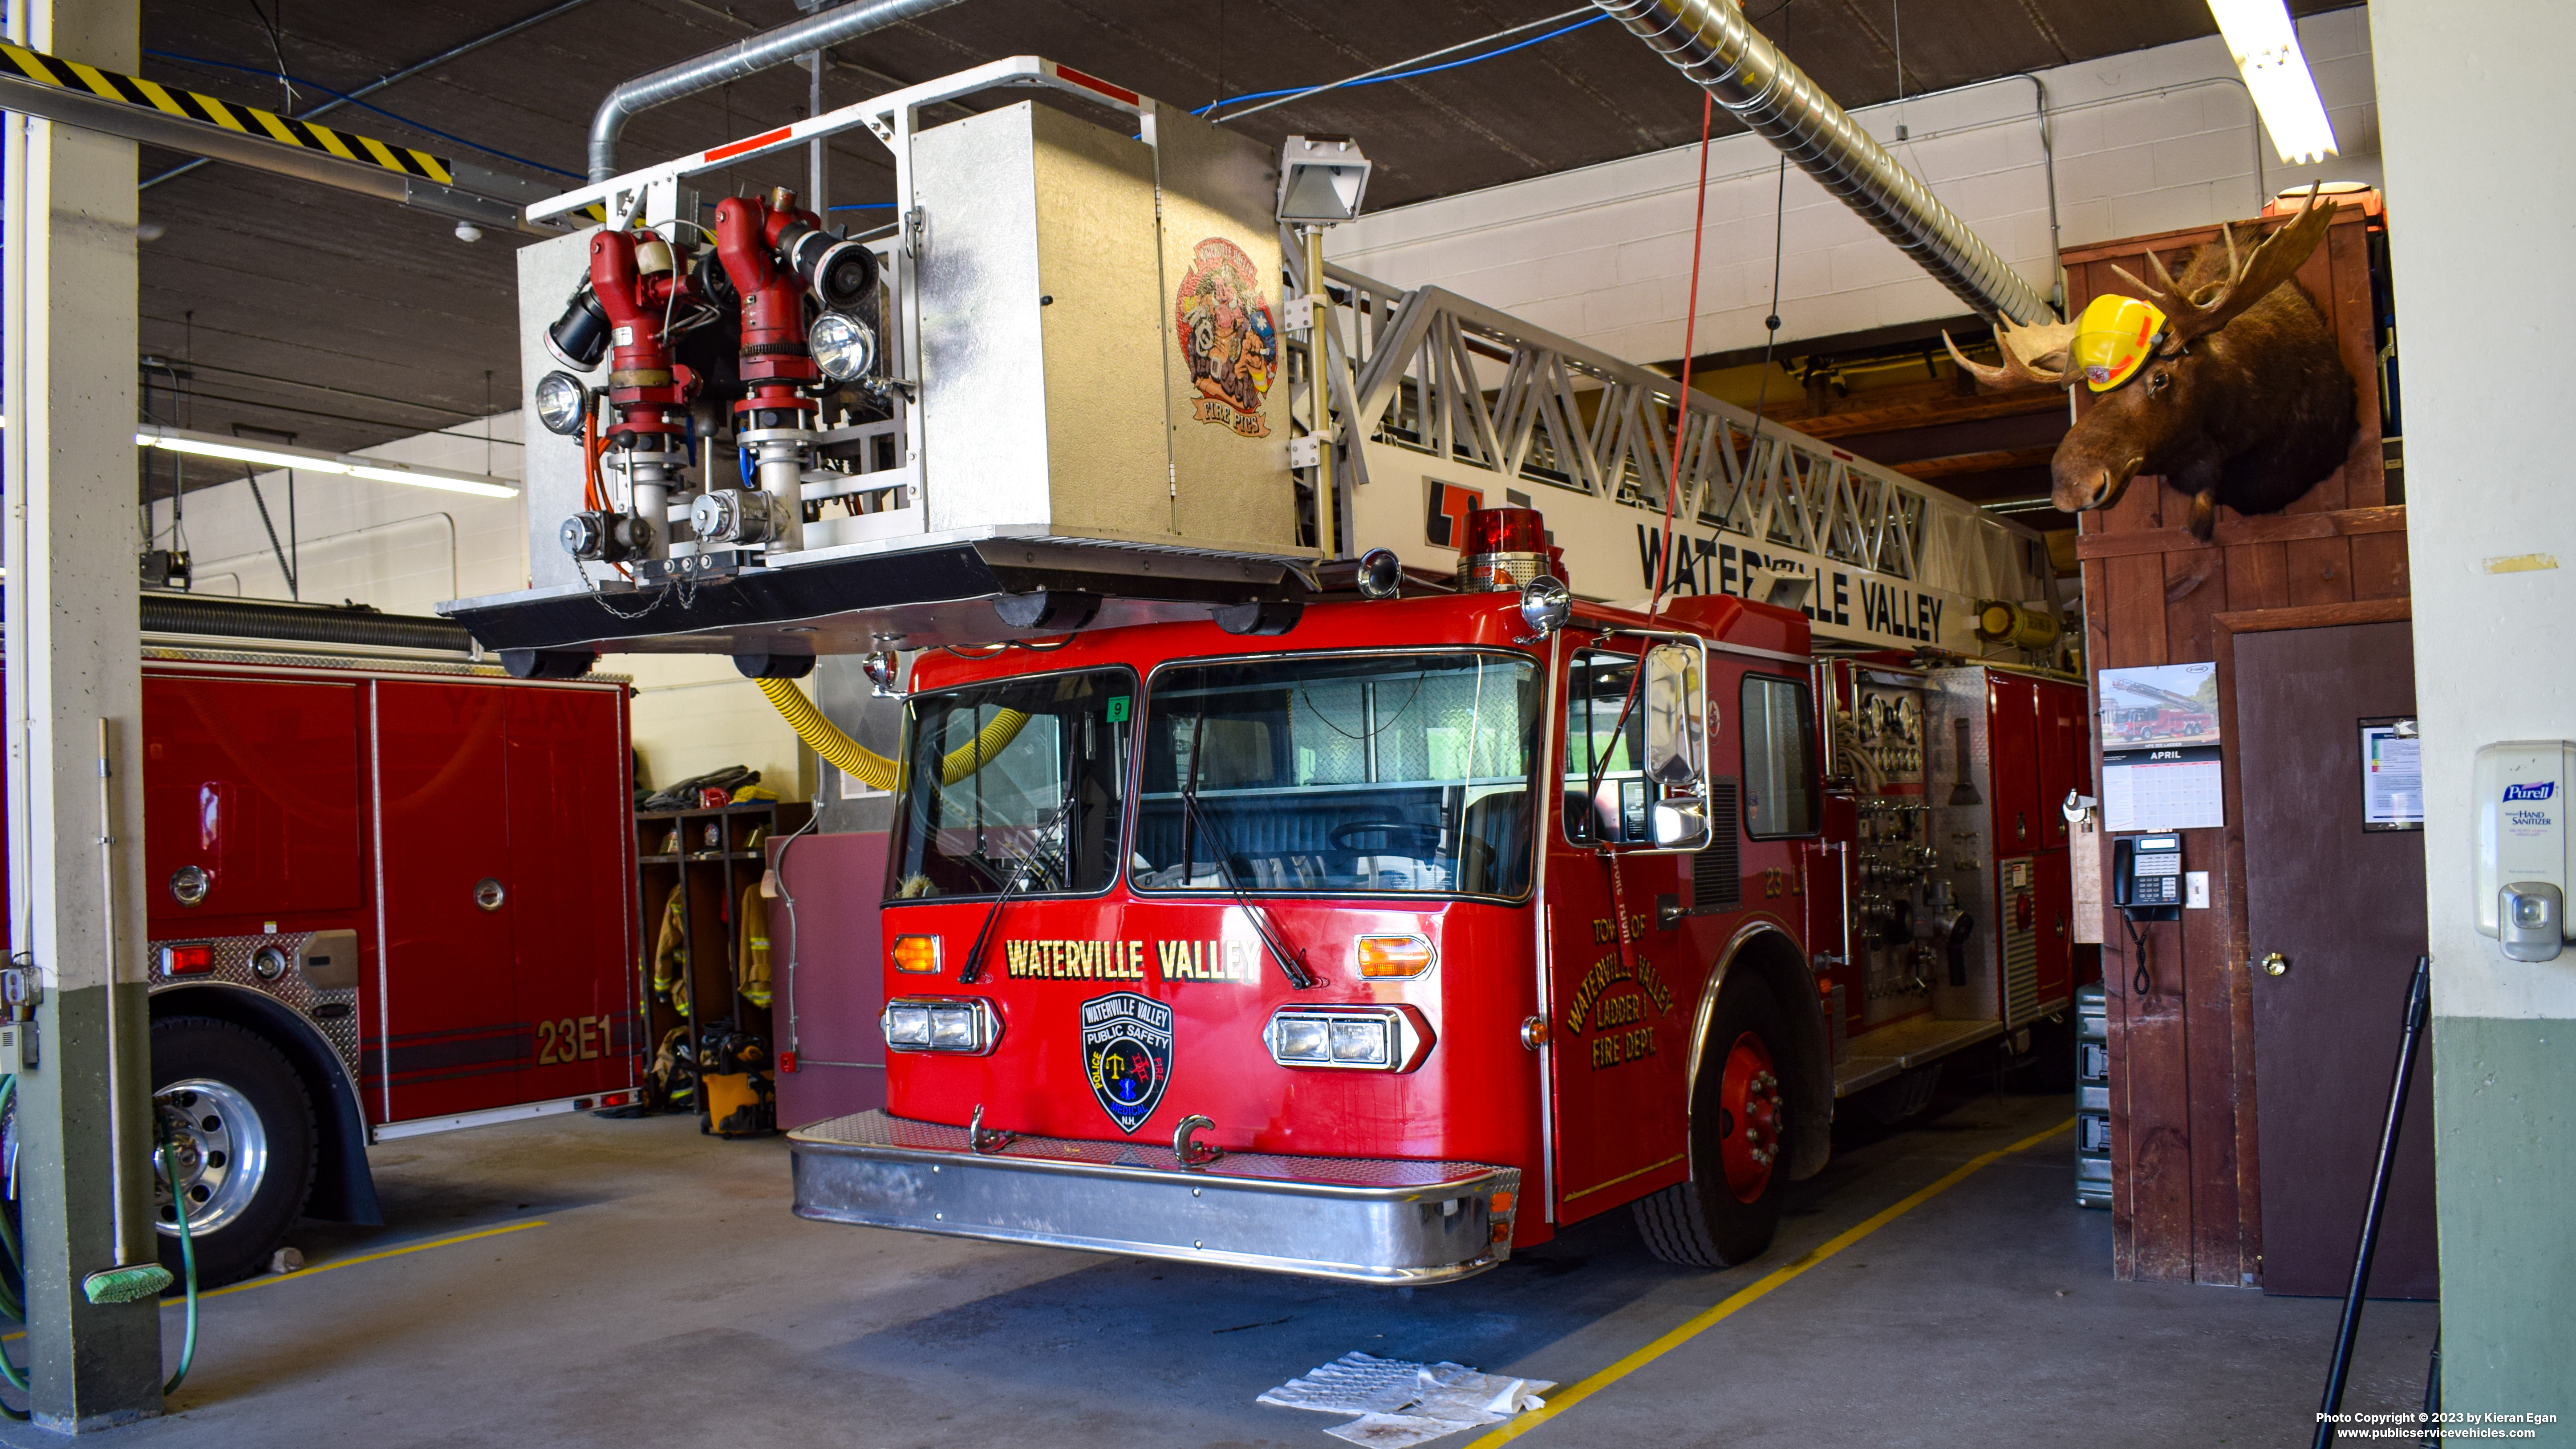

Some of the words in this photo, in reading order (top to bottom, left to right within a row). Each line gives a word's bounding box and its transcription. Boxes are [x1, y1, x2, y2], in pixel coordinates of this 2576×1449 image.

[1204, 402, 1230, 424] FIRE
[1233, 413, 1260, 434] PIGS
[1637, 524, 1849, 626] WATERLE
[1861, 579, 1943, 643] VALLEY
[1114, 702, 1122, 715] 9
[2150, 751, 2181, 759] APRIL
[2508, 786, 2549, 799] Purell
[2512, 817, 2551, 825] SANITIZER
[1765, 866, 1782, 899] 23
[1593, 917, 1616, 943] TOW
[1631, 914, 1646, 939] OF
[1006, 939, 1144, 979] WATERVILLE
[1157, 940, 1262, 982] VALLEY
[1638, 954, 1673, 1019] VALLEY
[1085, 998, 1135, 1023] WATERVILLE
[1137, 1002, 1168, 1027] VALLEY
[1596, 993, 1639, 1029] LADDER
[537, 1014, 611, 1066] 23E1
[1087, 1025, 1124, 1045] PUBLIC
[1127, 1025, 1169, 1049] SAFETY
[1592, 1035, 1620, 1069] FIRE
[1625, 1027, 1656, 1059] DEPT.
[1091, 1051, 1103, 1089] POLICE
[1153, 1057, 1164, 1082] FIRE
[1111, 1101, 1148, 1116] MEDICAL
[1122, 1116, 1136, 1125] N.H.
